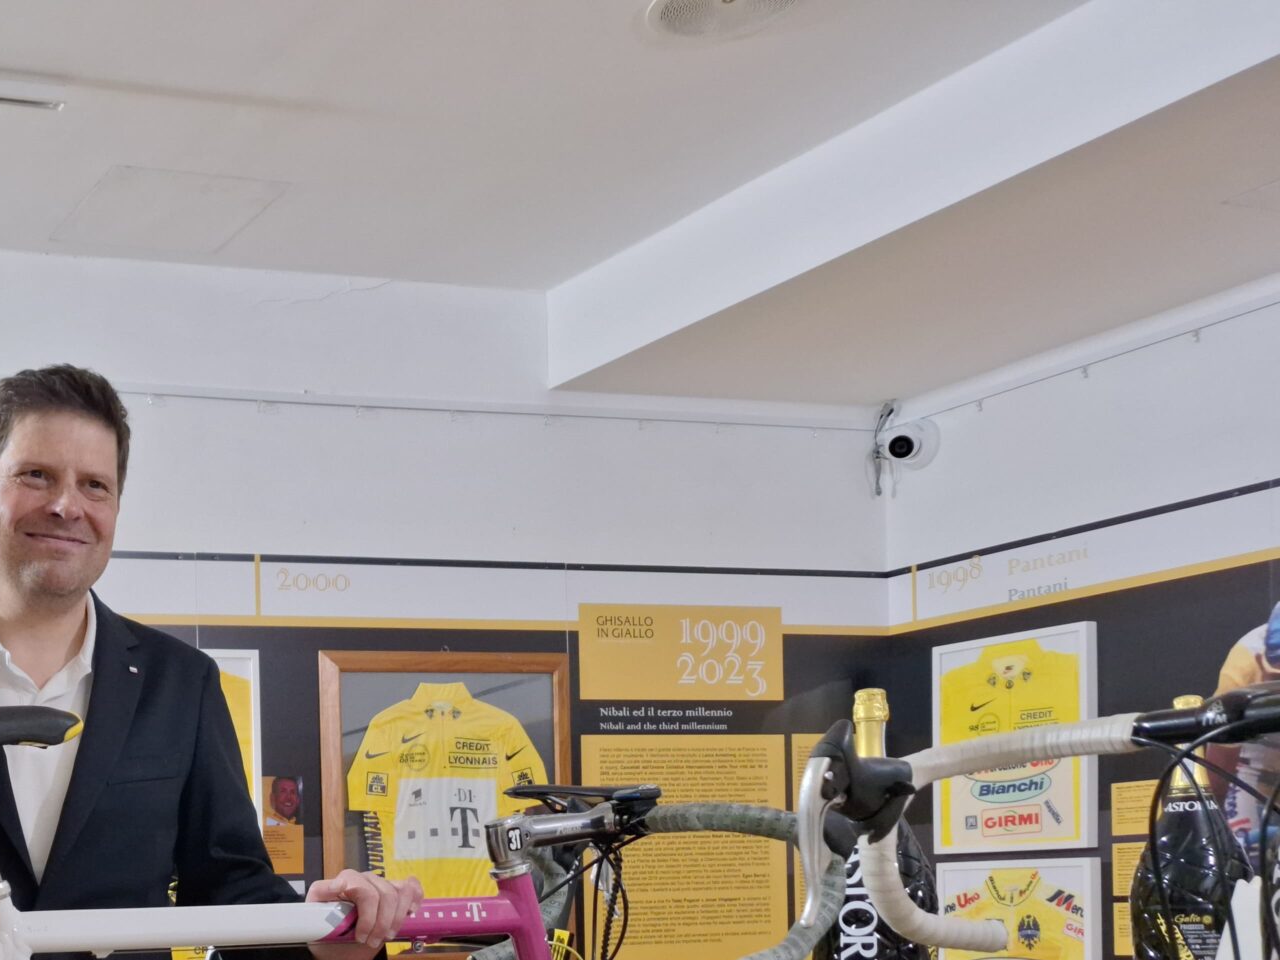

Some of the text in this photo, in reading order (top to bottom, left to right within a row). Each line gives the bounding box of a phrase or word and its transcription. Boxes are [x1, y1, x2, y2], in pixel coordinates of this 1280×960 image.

[927, 543, 1089, 595] 1998 Pantani
[276, 567, 351, 592] 2000
[1007, 577, 1069, 602] Pantani
[596, 615, 654, 627] GHISALLO
[597, 627, 655, 639] IN GIALLO
[679, 617, 766, 657] 1999
[676, 652, 767, 697] 2023
[600, 706, 733, 718] Nibali ed il terzo millennio
[1019, 710, 1053, 721] CREDIT
[600, 722, 728, 731] Nibali and the third millennium
[455, 741, 491, 752] CREDIT
[448, 755, 498, 766] LYONNAIS
[978, 778, 1045, 797] Bianchi
[449, 806, 480, 849] T
[983, 812, 1040, 829] GIRMI
[956, 892, 981, 909] Uno
